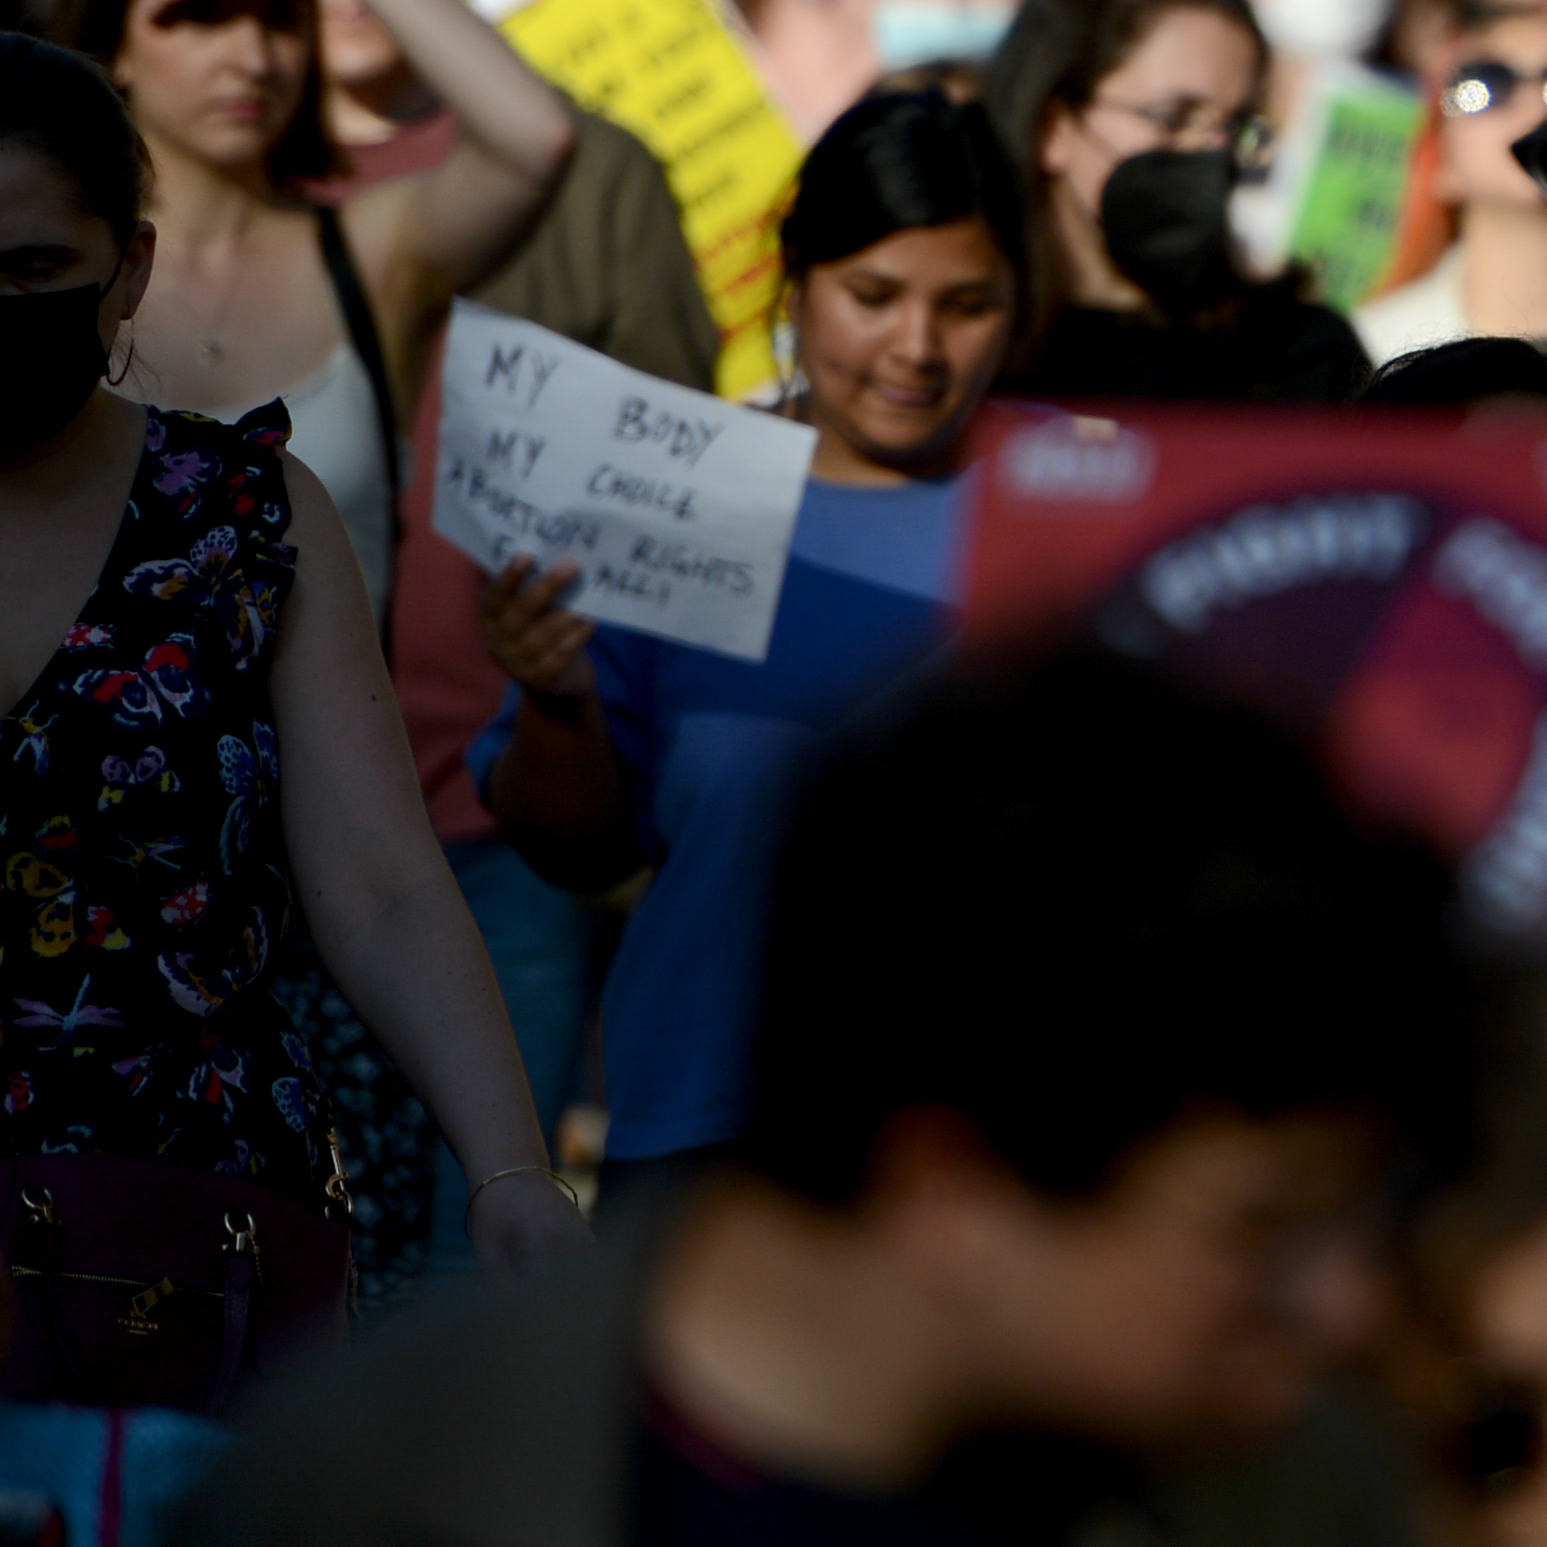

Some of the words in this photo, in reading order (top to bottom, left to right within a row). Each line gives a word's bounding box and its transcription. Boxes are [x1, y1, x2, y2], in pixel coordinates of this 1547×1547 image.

[484, 341, 563, 408] MY
[612, 395, 723, 469] BODY
[448, 458, 602, 552] ABORTION
[629, 534, 757, 596] RIGHTS
[486, 429, 547, 481] MY
[585, 463, 698, 521] CHOICE
